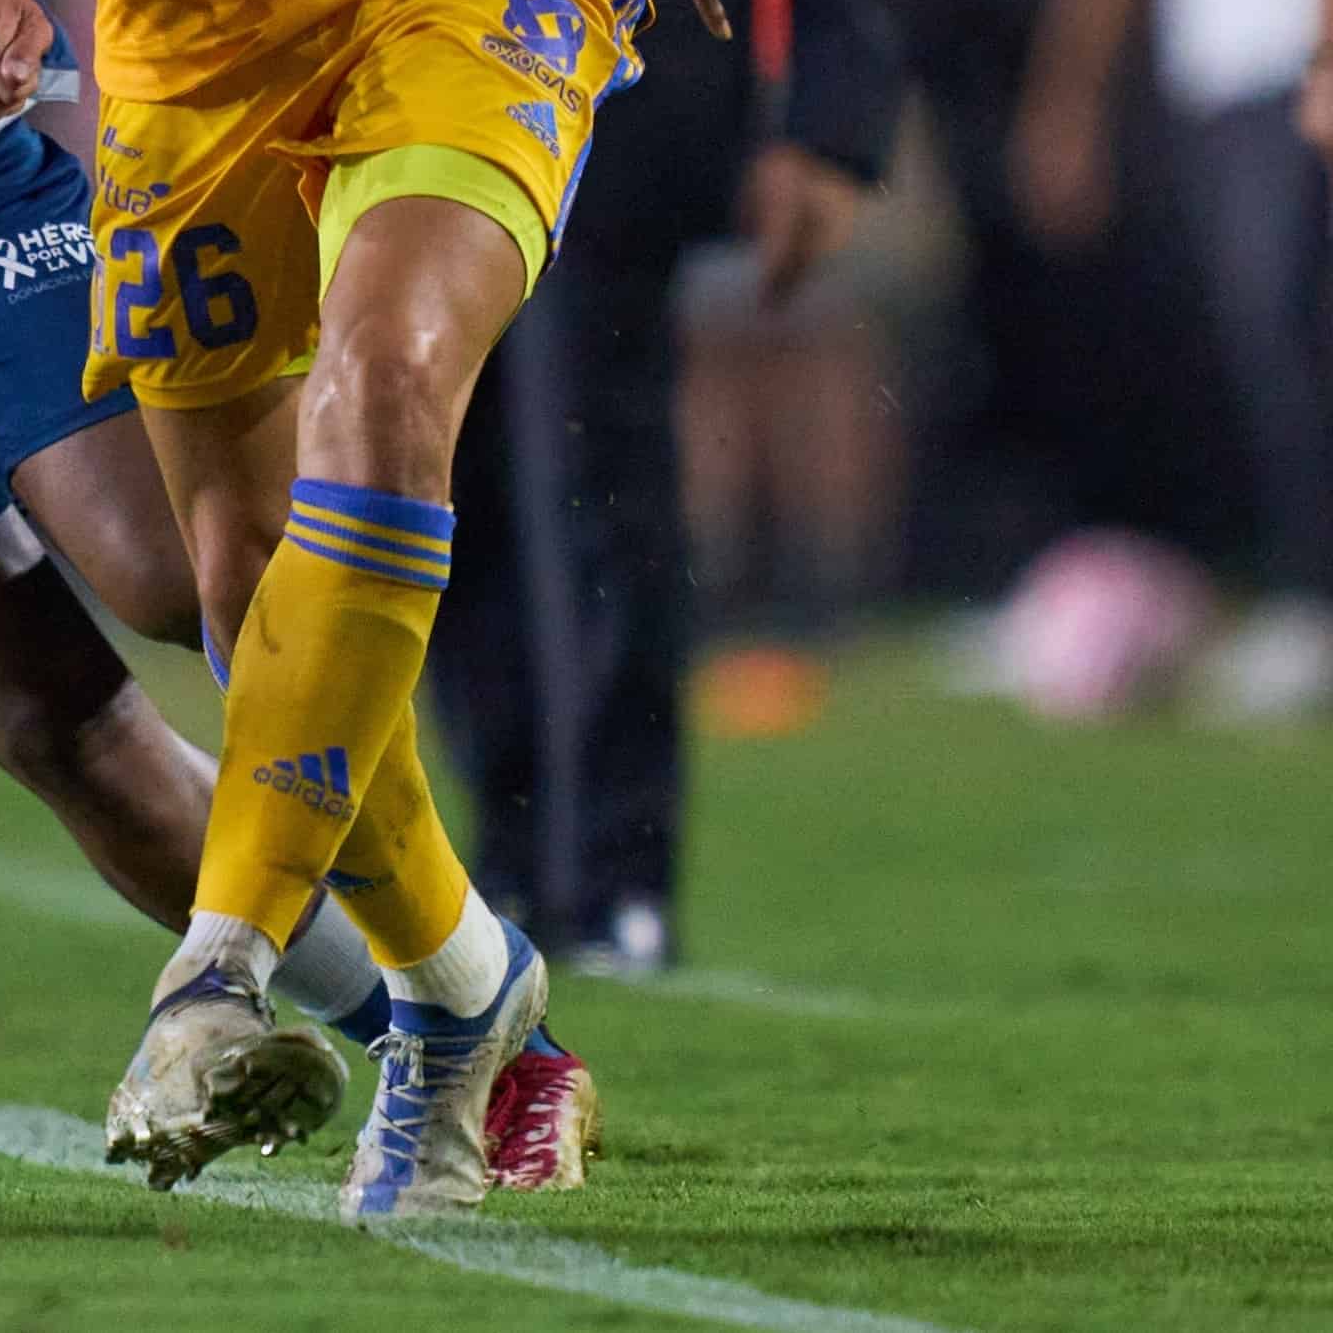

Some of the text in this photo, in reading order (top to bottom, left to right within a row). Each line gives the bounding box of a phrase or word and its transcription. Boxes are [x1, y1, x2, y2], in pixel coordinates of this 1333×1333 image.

[26, 246, 65, 265] POR
[45, 257, 71, 272] LA
[108, 222, 259, 359] 26
[252, 765, 356, 821] adidas
